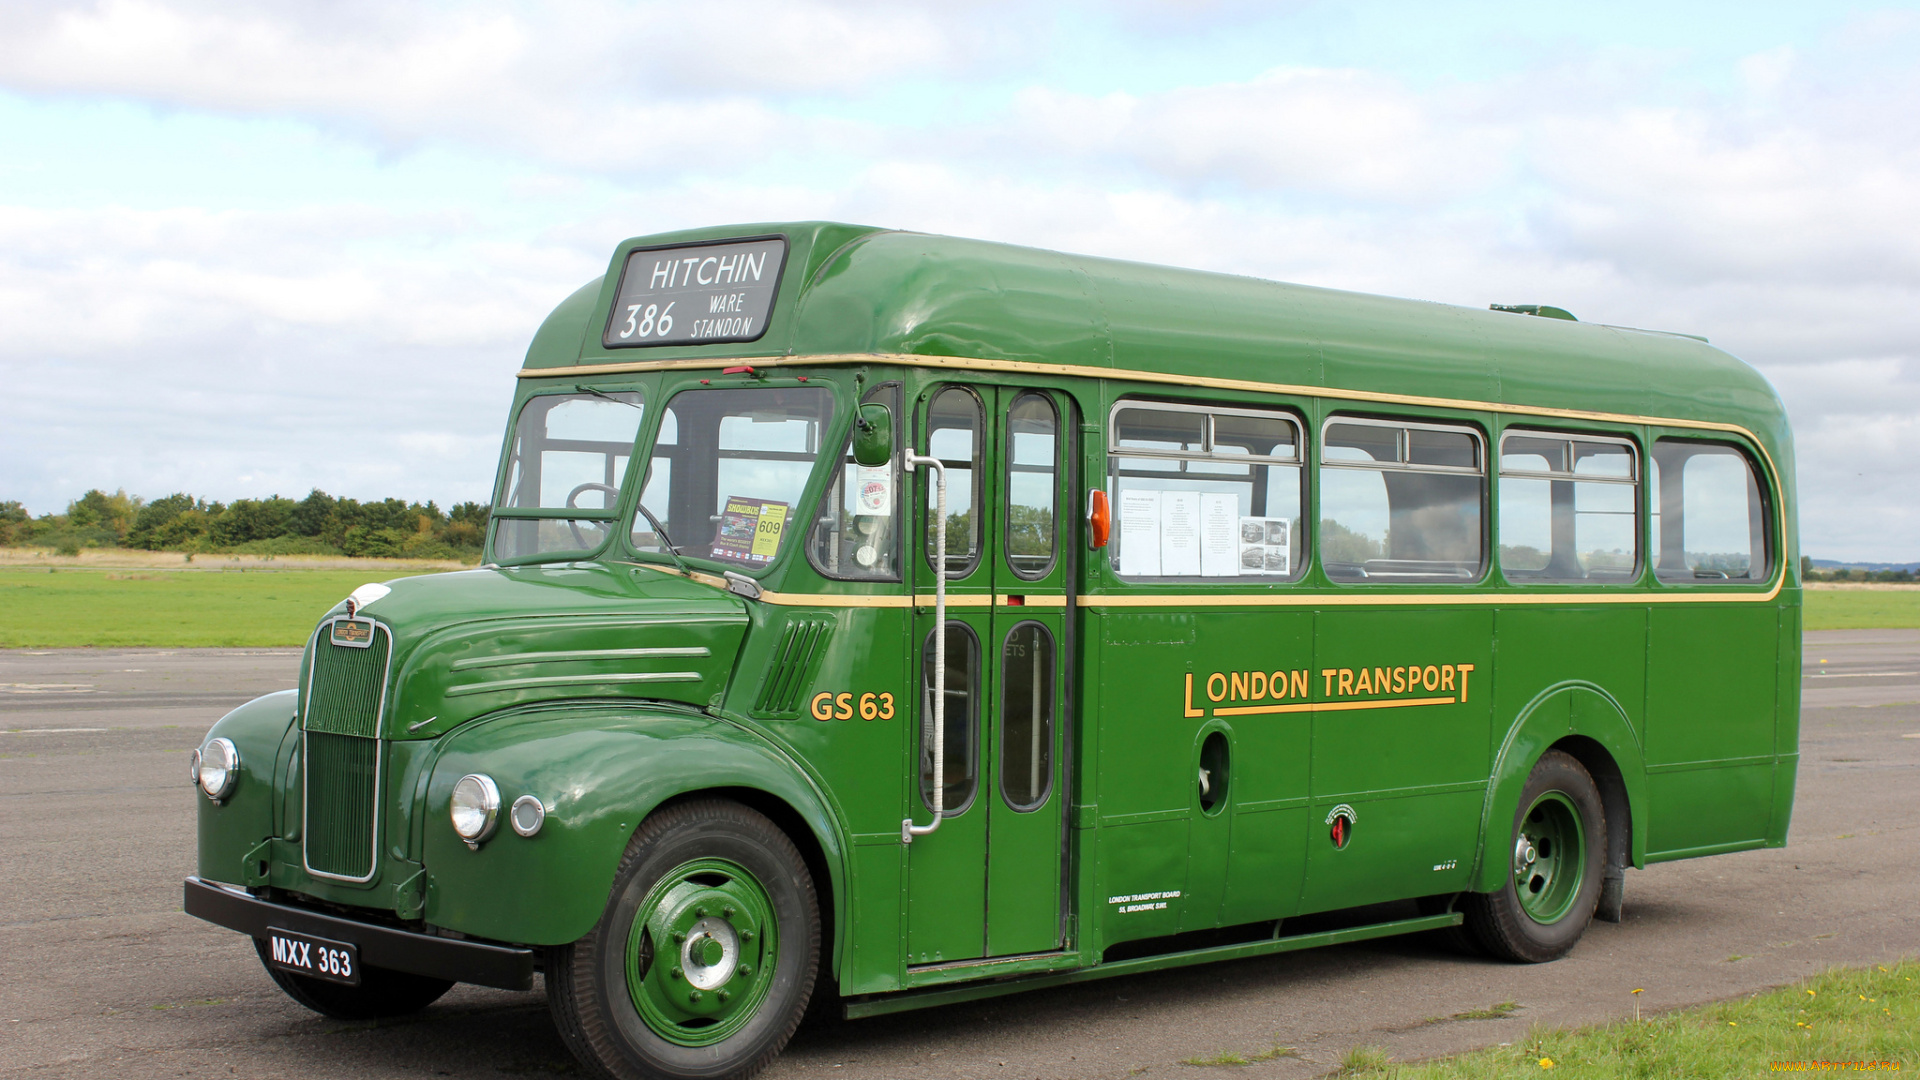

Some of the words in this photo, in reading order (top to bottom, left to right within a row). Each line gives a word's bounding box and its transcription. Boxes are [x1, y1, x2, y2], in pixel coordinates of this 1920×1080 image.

[649, 251, 767, 290] HITCHIN
[709, 292, 746, 314] WARE
[619, 301, 676, 339] 386
[690, 316, 753, 339] STANDON
[727, 503, 760, 516] SHOWBUS
[759, 520, 781, 535] 609
[1184, 669, 1309, 718] LONDON
[1321, 663, 1475, 704] TRANSPORT
[811, 691, 854, 722] GS
[859, 691, 896, 721] 63
[1108, 895, 1131, 904] LONDON
[1131, 892, 1162, 902] TRANSPORT
[1162, 890, 1181, 899] BOARD
[272, 935, 312, 969] MXX
[318, 946, 352, 977] 363
